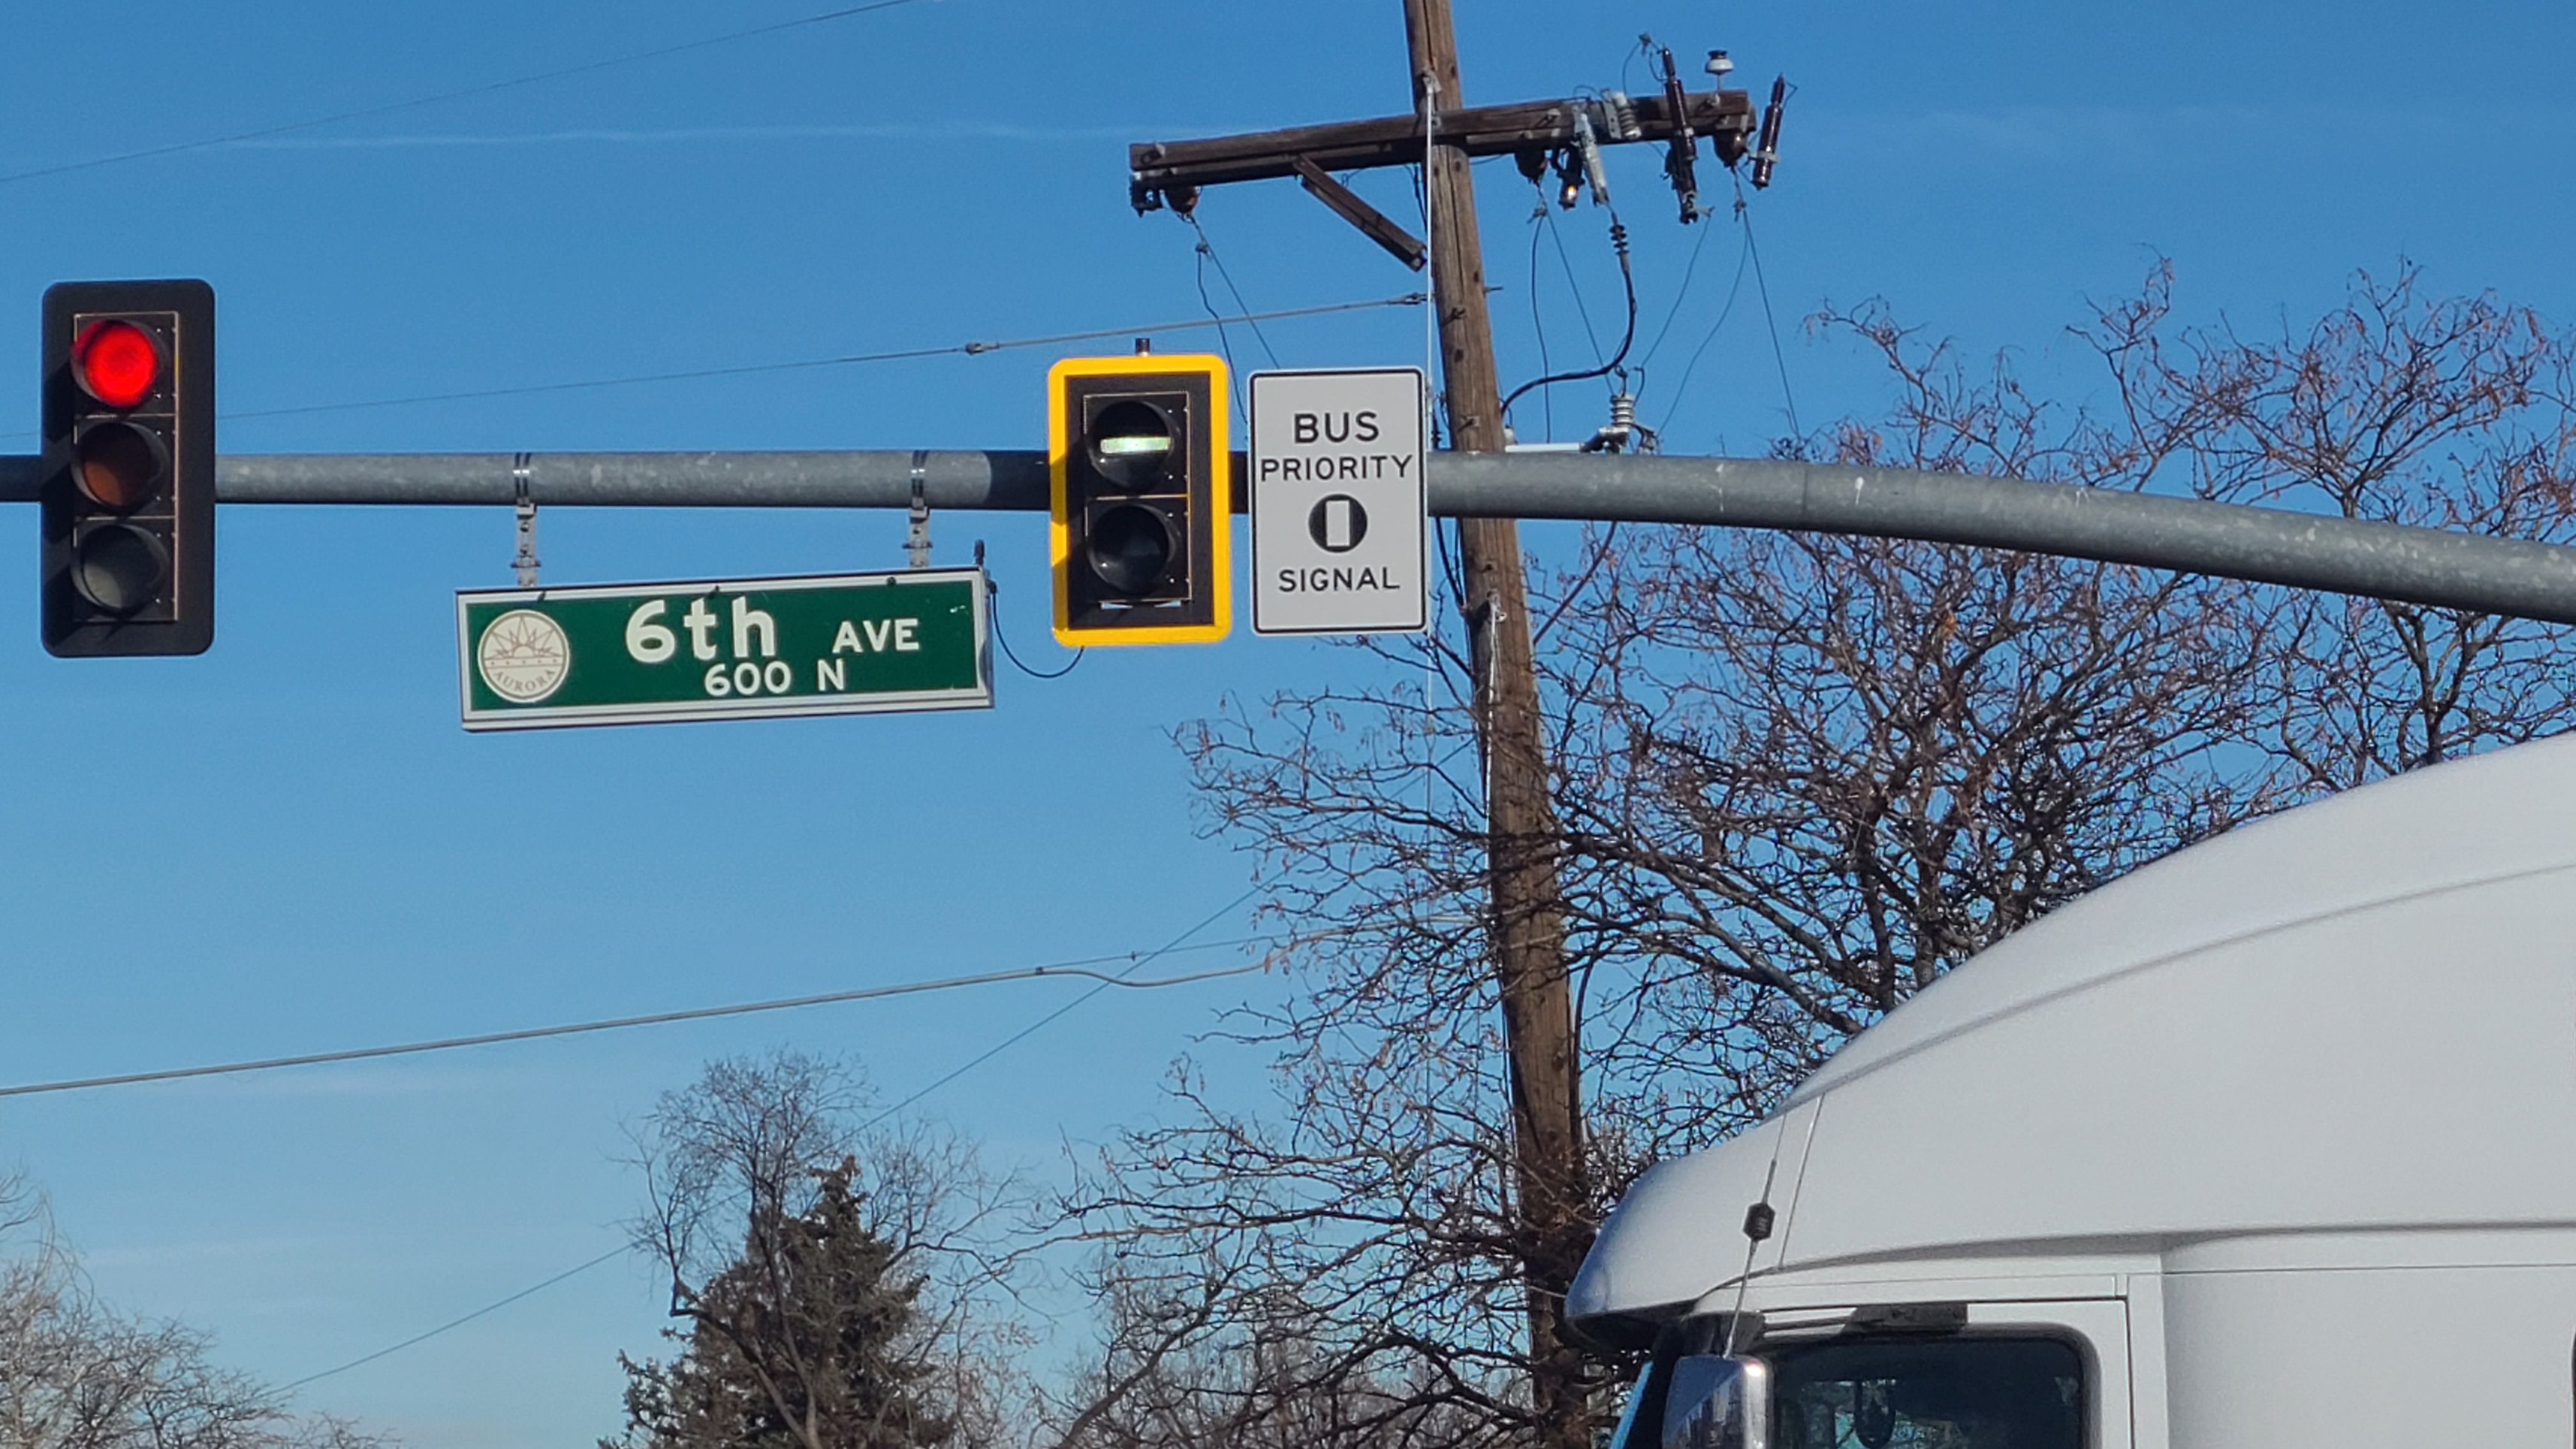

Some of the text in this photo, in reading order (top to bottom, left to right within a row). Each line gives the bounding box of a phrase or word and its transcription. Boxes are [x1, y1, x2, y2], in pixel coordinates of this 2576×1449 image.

[1294, 411, 1379, 443] BUS
[1261, 454, 1413, 482] PRIORITY
[1278, 566, 1401, 592] SIGNAL
[625, 595, 920, 663] 6th AVE
[493, 669, 555, 692] AURORA
[705, 659, 846, 696] 600 N
